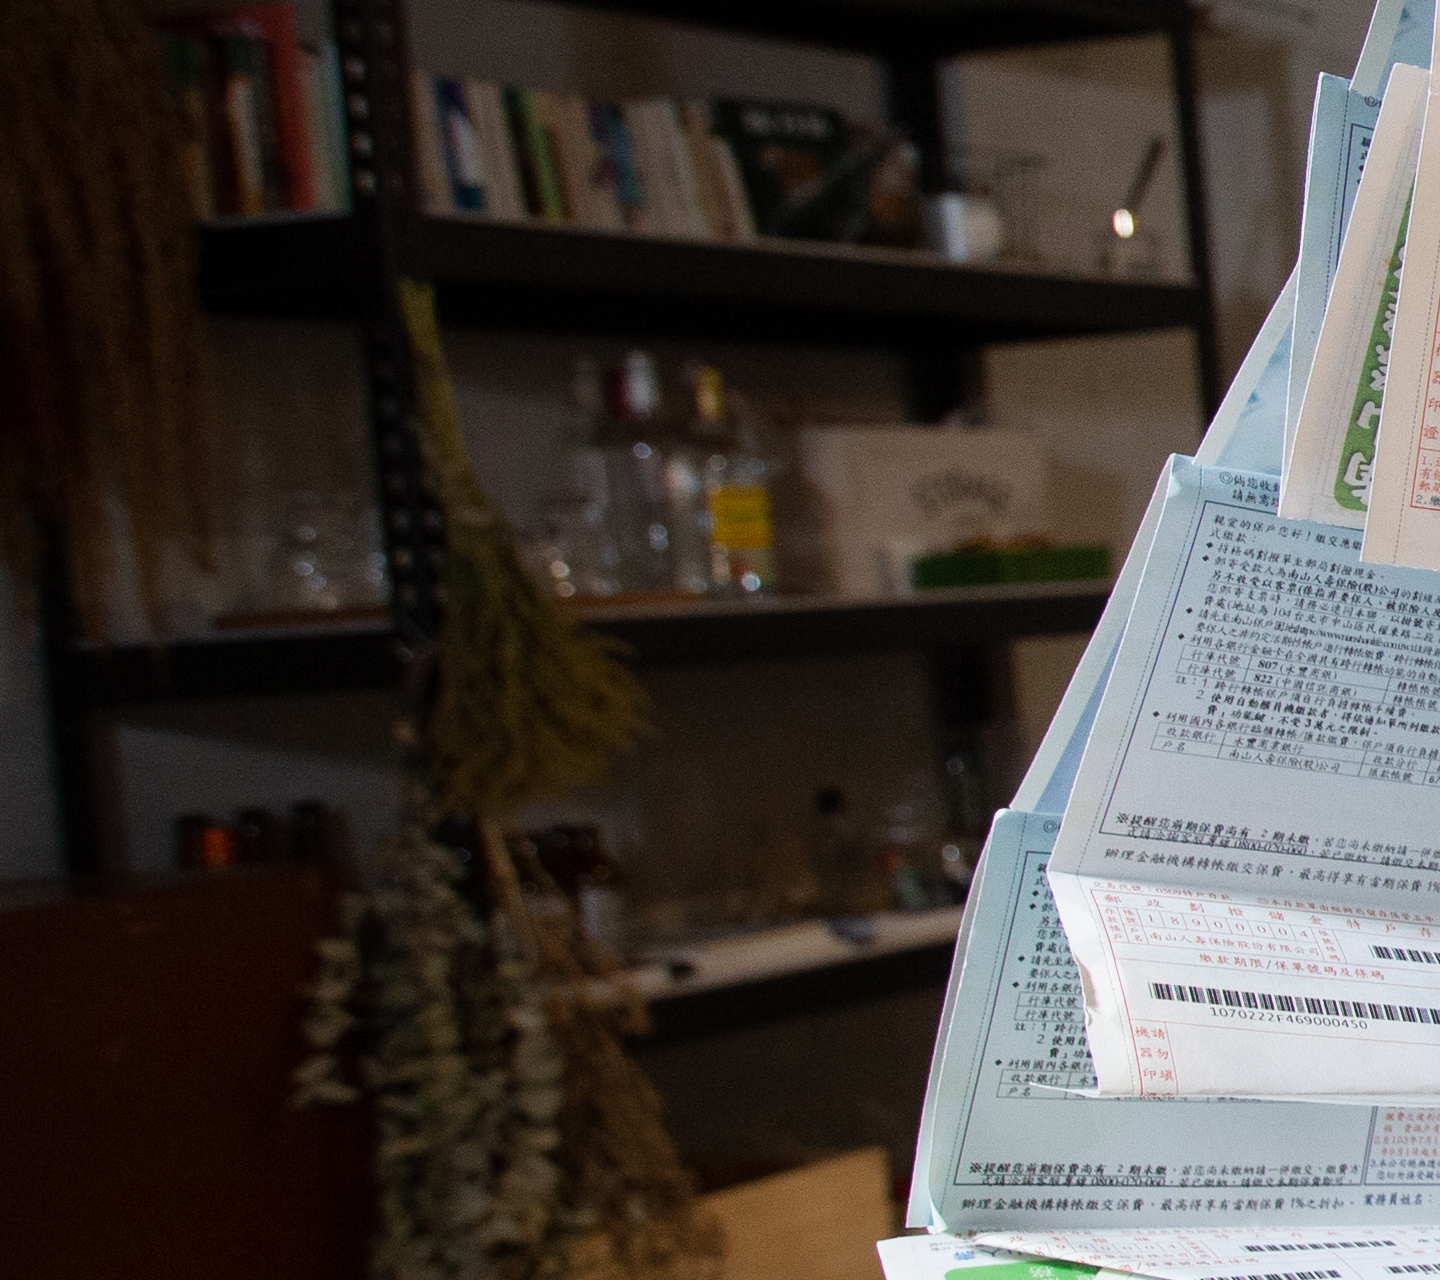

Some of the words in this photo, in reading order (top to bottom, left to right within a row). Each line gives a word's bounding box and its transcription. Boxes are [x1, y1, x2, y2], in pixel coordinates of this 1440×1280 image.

[1149, 930, 1320, 959] 南山人壽保險股份有限公司
[1210, 1007, 1368, 1030] 1070222F469000450
